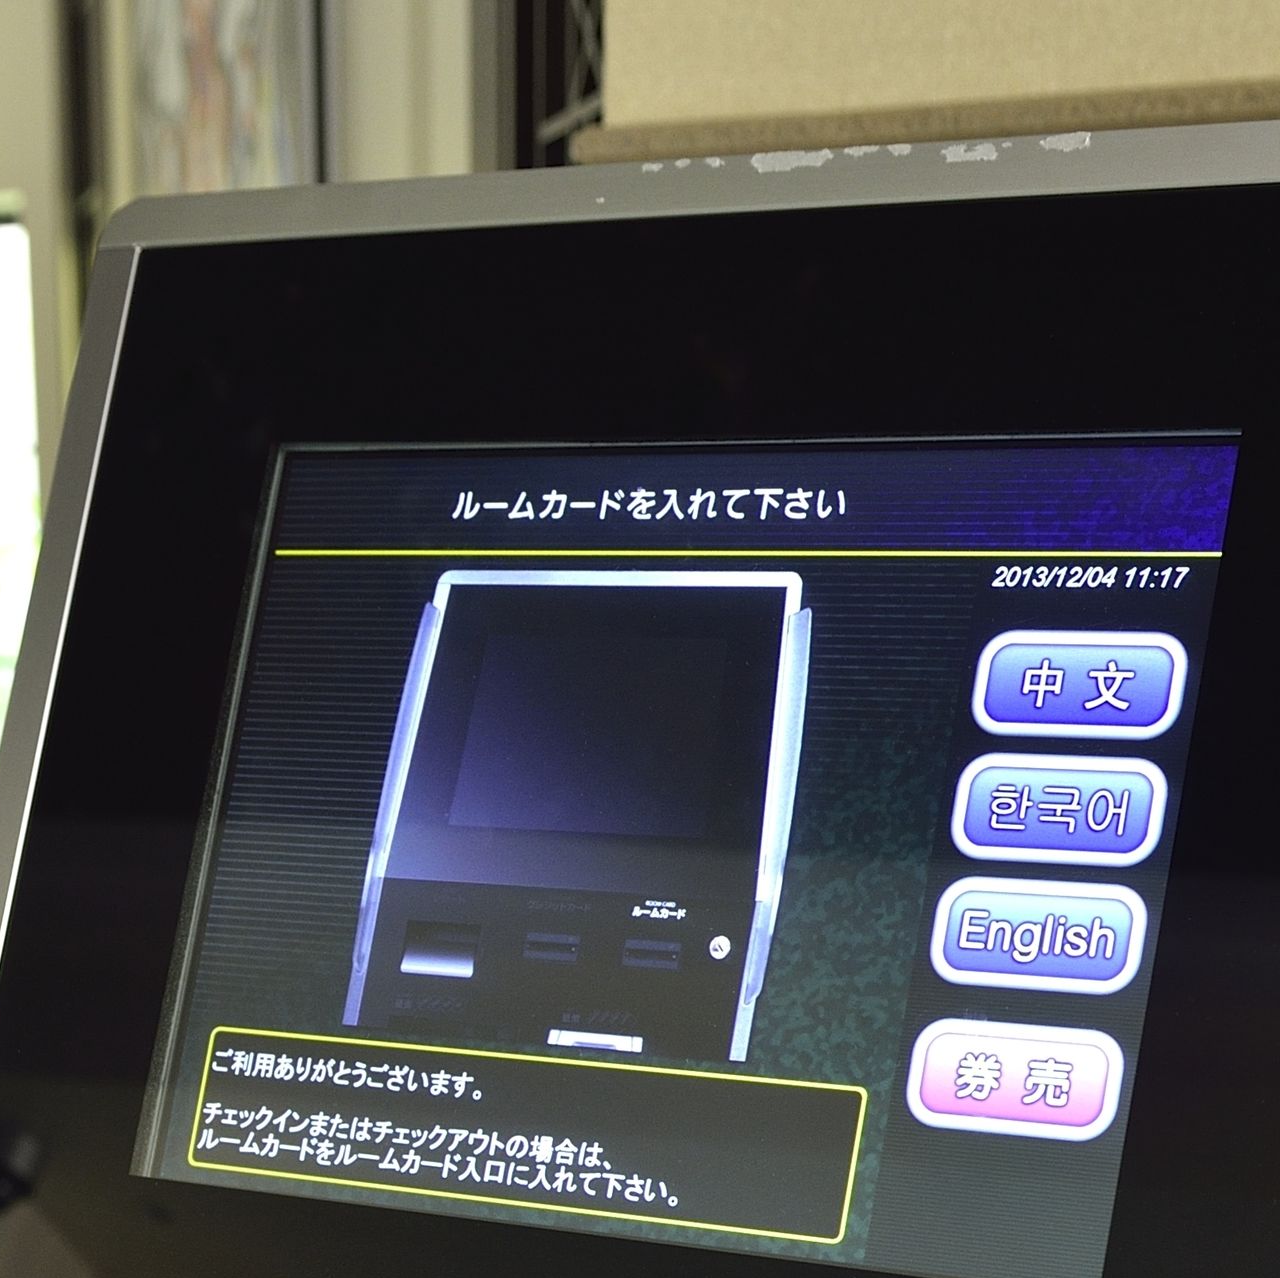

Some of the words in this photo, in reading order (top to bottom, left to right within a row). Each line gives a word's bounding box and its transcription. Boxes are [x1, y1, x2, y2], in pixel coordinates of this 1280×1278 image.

[452, 488, 847, 521] ルームカードを入れて下さい
[991, 565, 1119, 589] 2013/12/04
[1124, 566, 1190, 589] 11:17
[1021, 657, 1136, 711] 中文
[990, 783, 1130, 837] 한국어
[958, 908, 1116, 963] English
[211, 1048, 484, 1101] ご利用ありがとうございます。
[953, 1051, 1074, 1108] 券売
[202, 1101, 613, 1170] チェックインまたはチェックアウトの場合は、
[196, 1127, 680, 1207] ルームカードをルームカード入口に入れて下さい。
